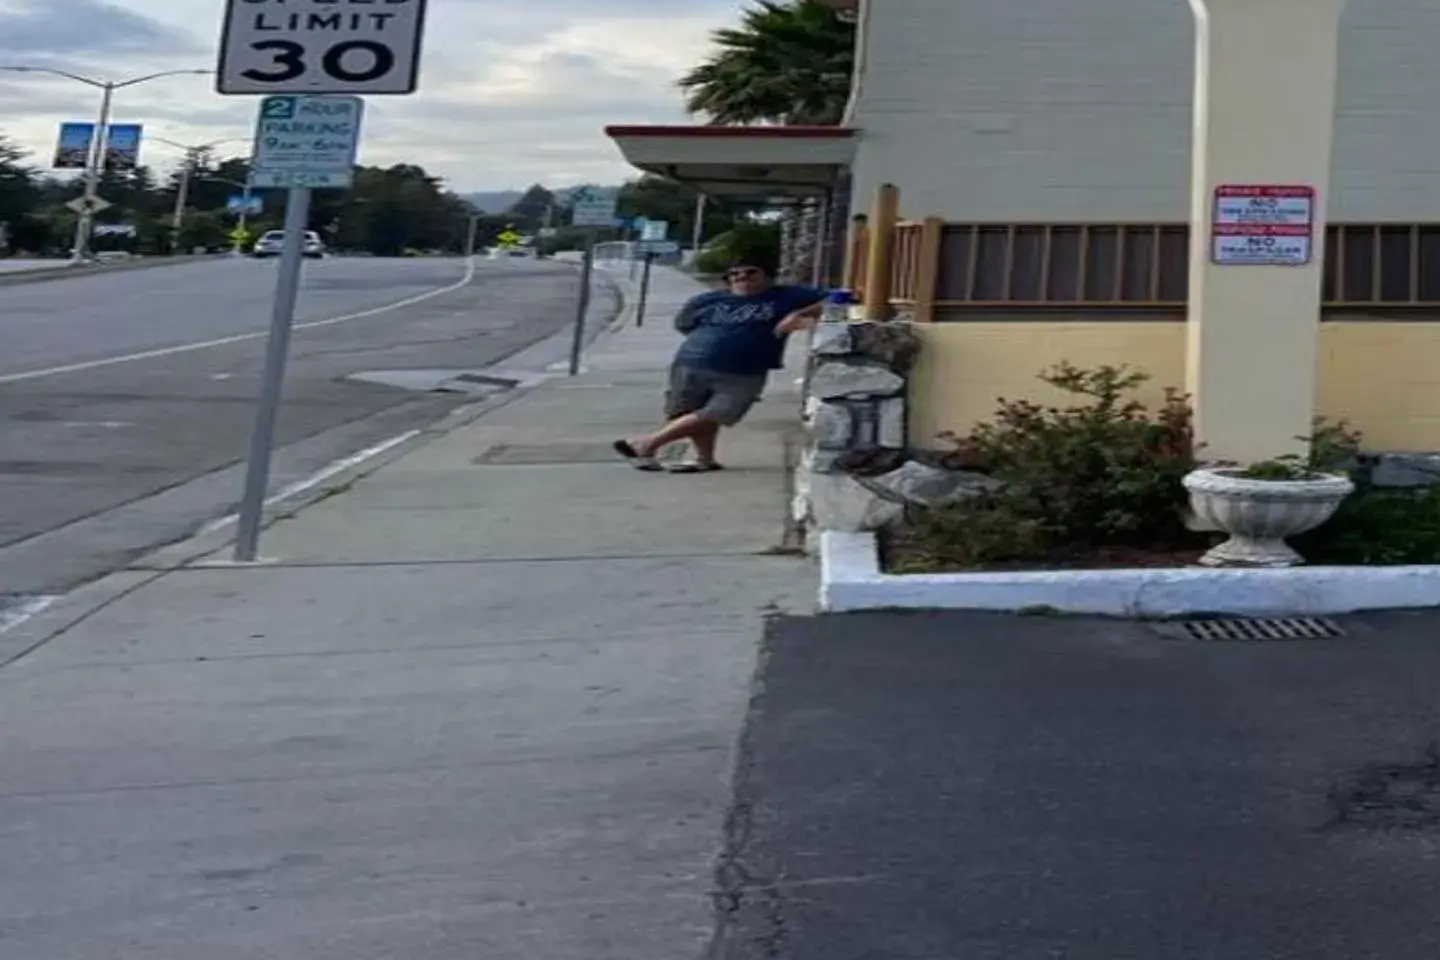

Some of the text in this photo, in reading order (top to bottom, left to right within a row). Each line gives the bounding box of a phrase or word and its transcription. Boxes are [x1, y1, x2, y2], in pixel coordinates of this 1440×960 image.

[254, 13, 396, 31] LIMIT
[239, 39, 395, 83] 30
[266, 99, 291, 116] 2
[265, 121, 351, 136] PARKING
[1247, 237, 1276, 246] NO
